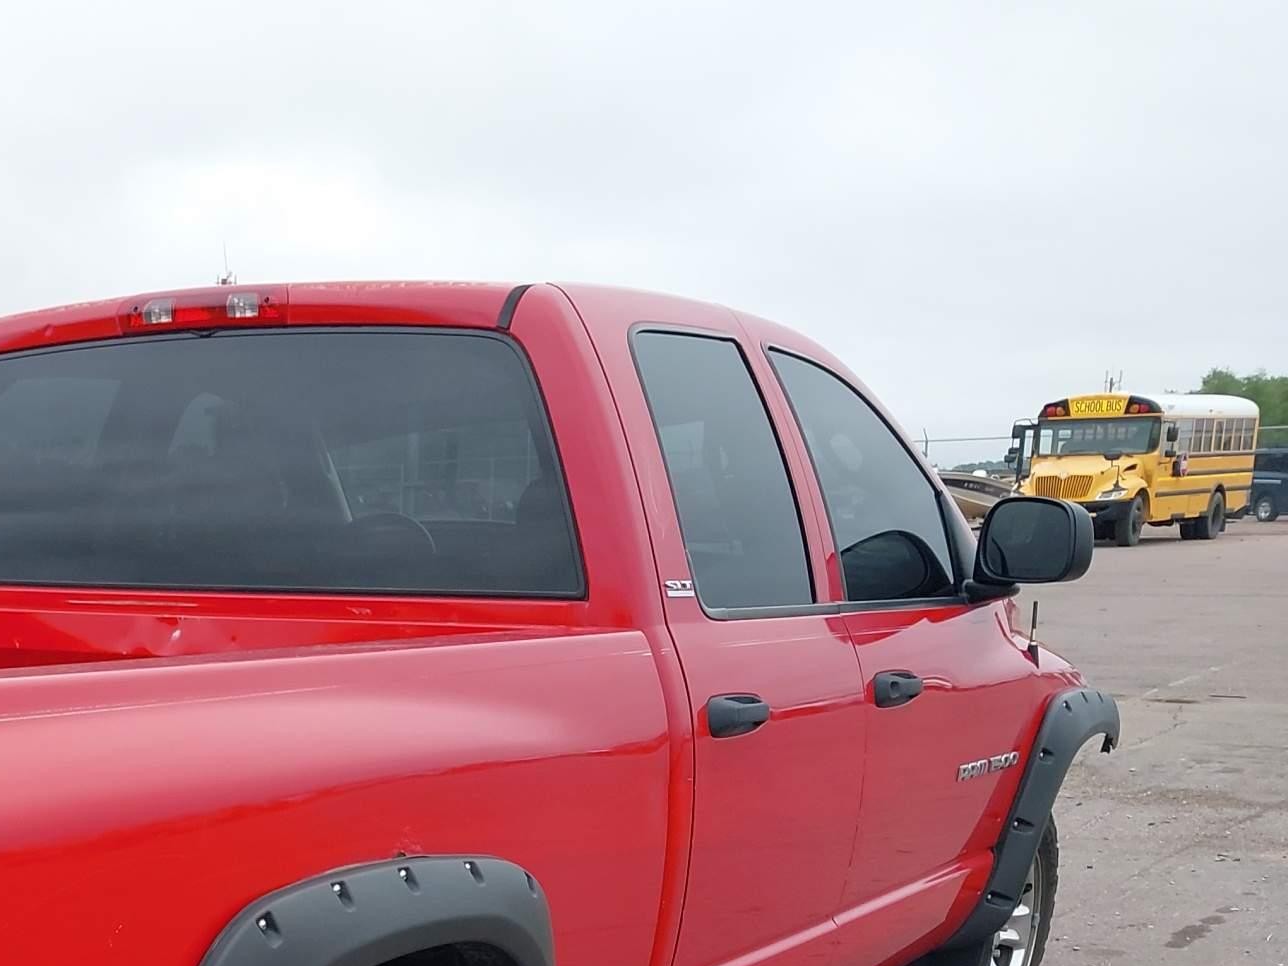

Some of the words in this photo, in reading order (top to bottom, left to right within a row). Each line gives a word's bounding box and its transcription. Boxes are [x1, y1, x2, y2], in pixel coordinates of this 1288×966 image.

[1075, 400, 1104, 413] SCHOOL
[1106, 399, 1122, 412] BUS
[957, 759, 989, 782] RAM
